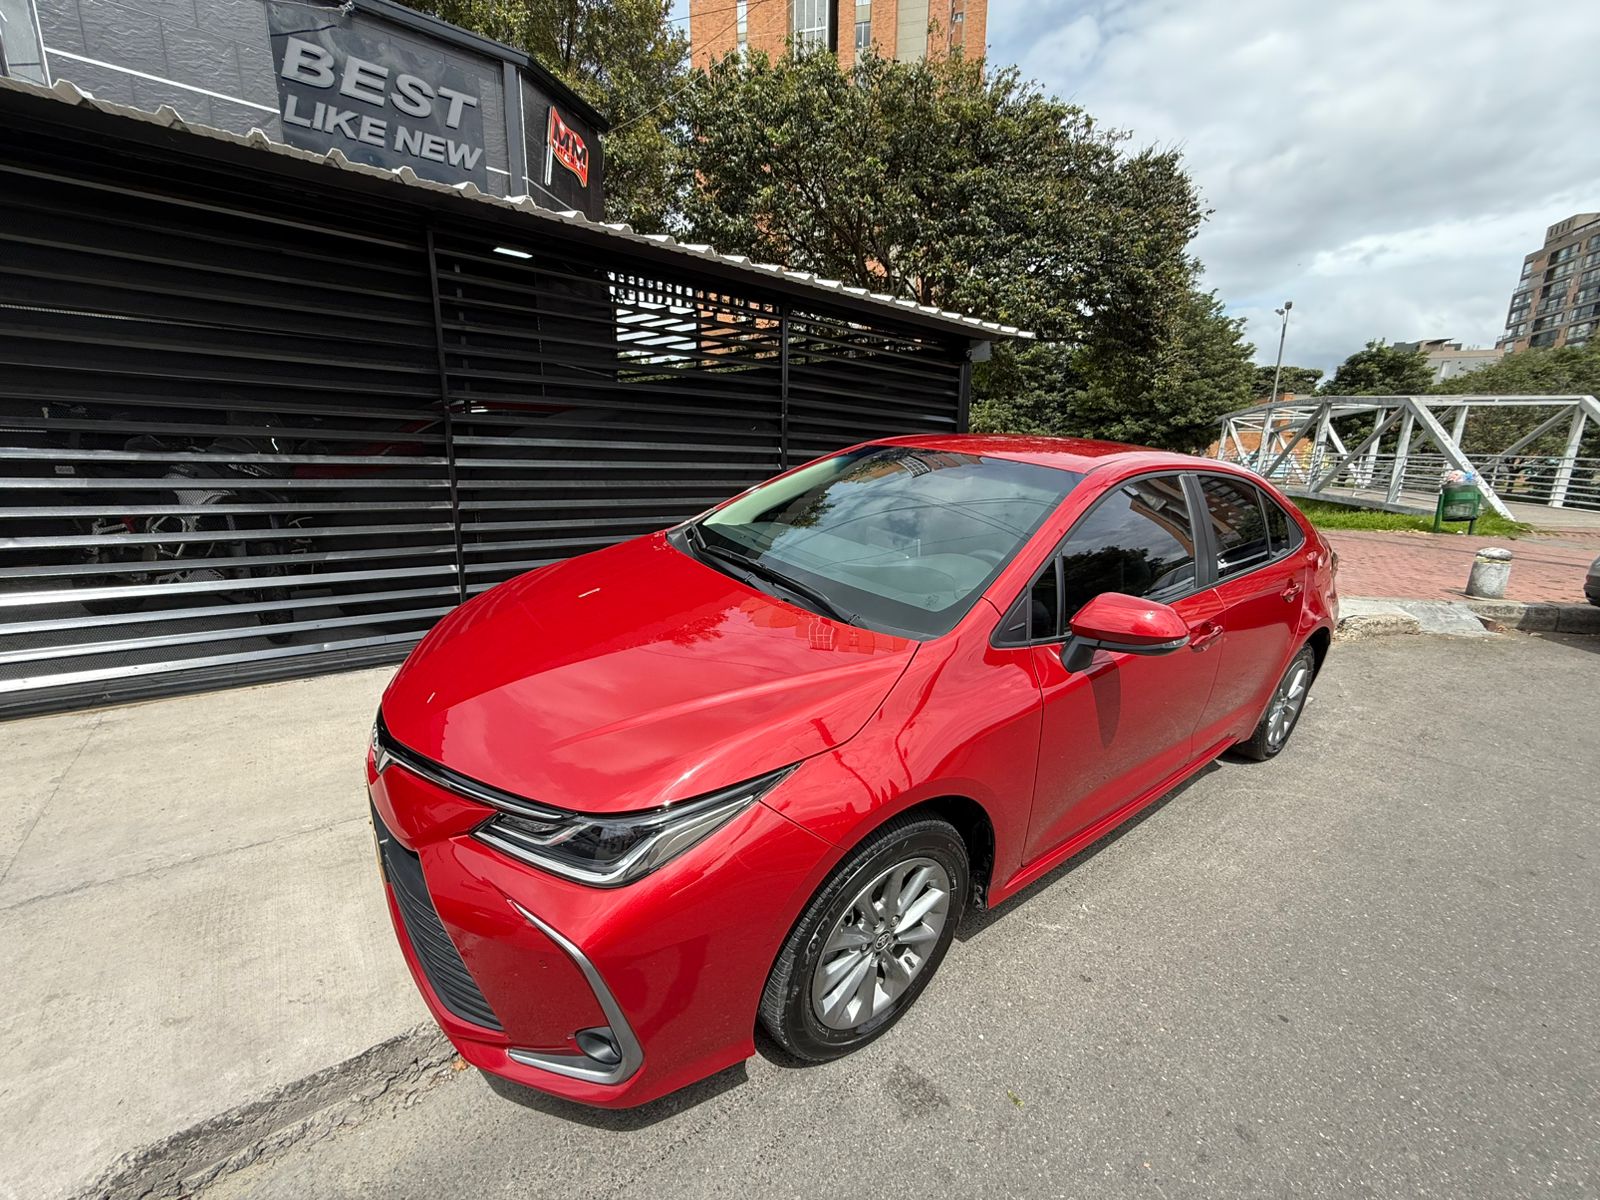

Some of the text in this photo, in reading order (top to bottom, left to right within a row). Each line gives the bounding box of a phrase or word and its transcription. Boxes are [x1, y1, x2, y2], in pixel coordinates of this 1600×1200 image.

[281, 36, 478, 130] BEST
[283, 94, 483, 171] LIKE NEW
